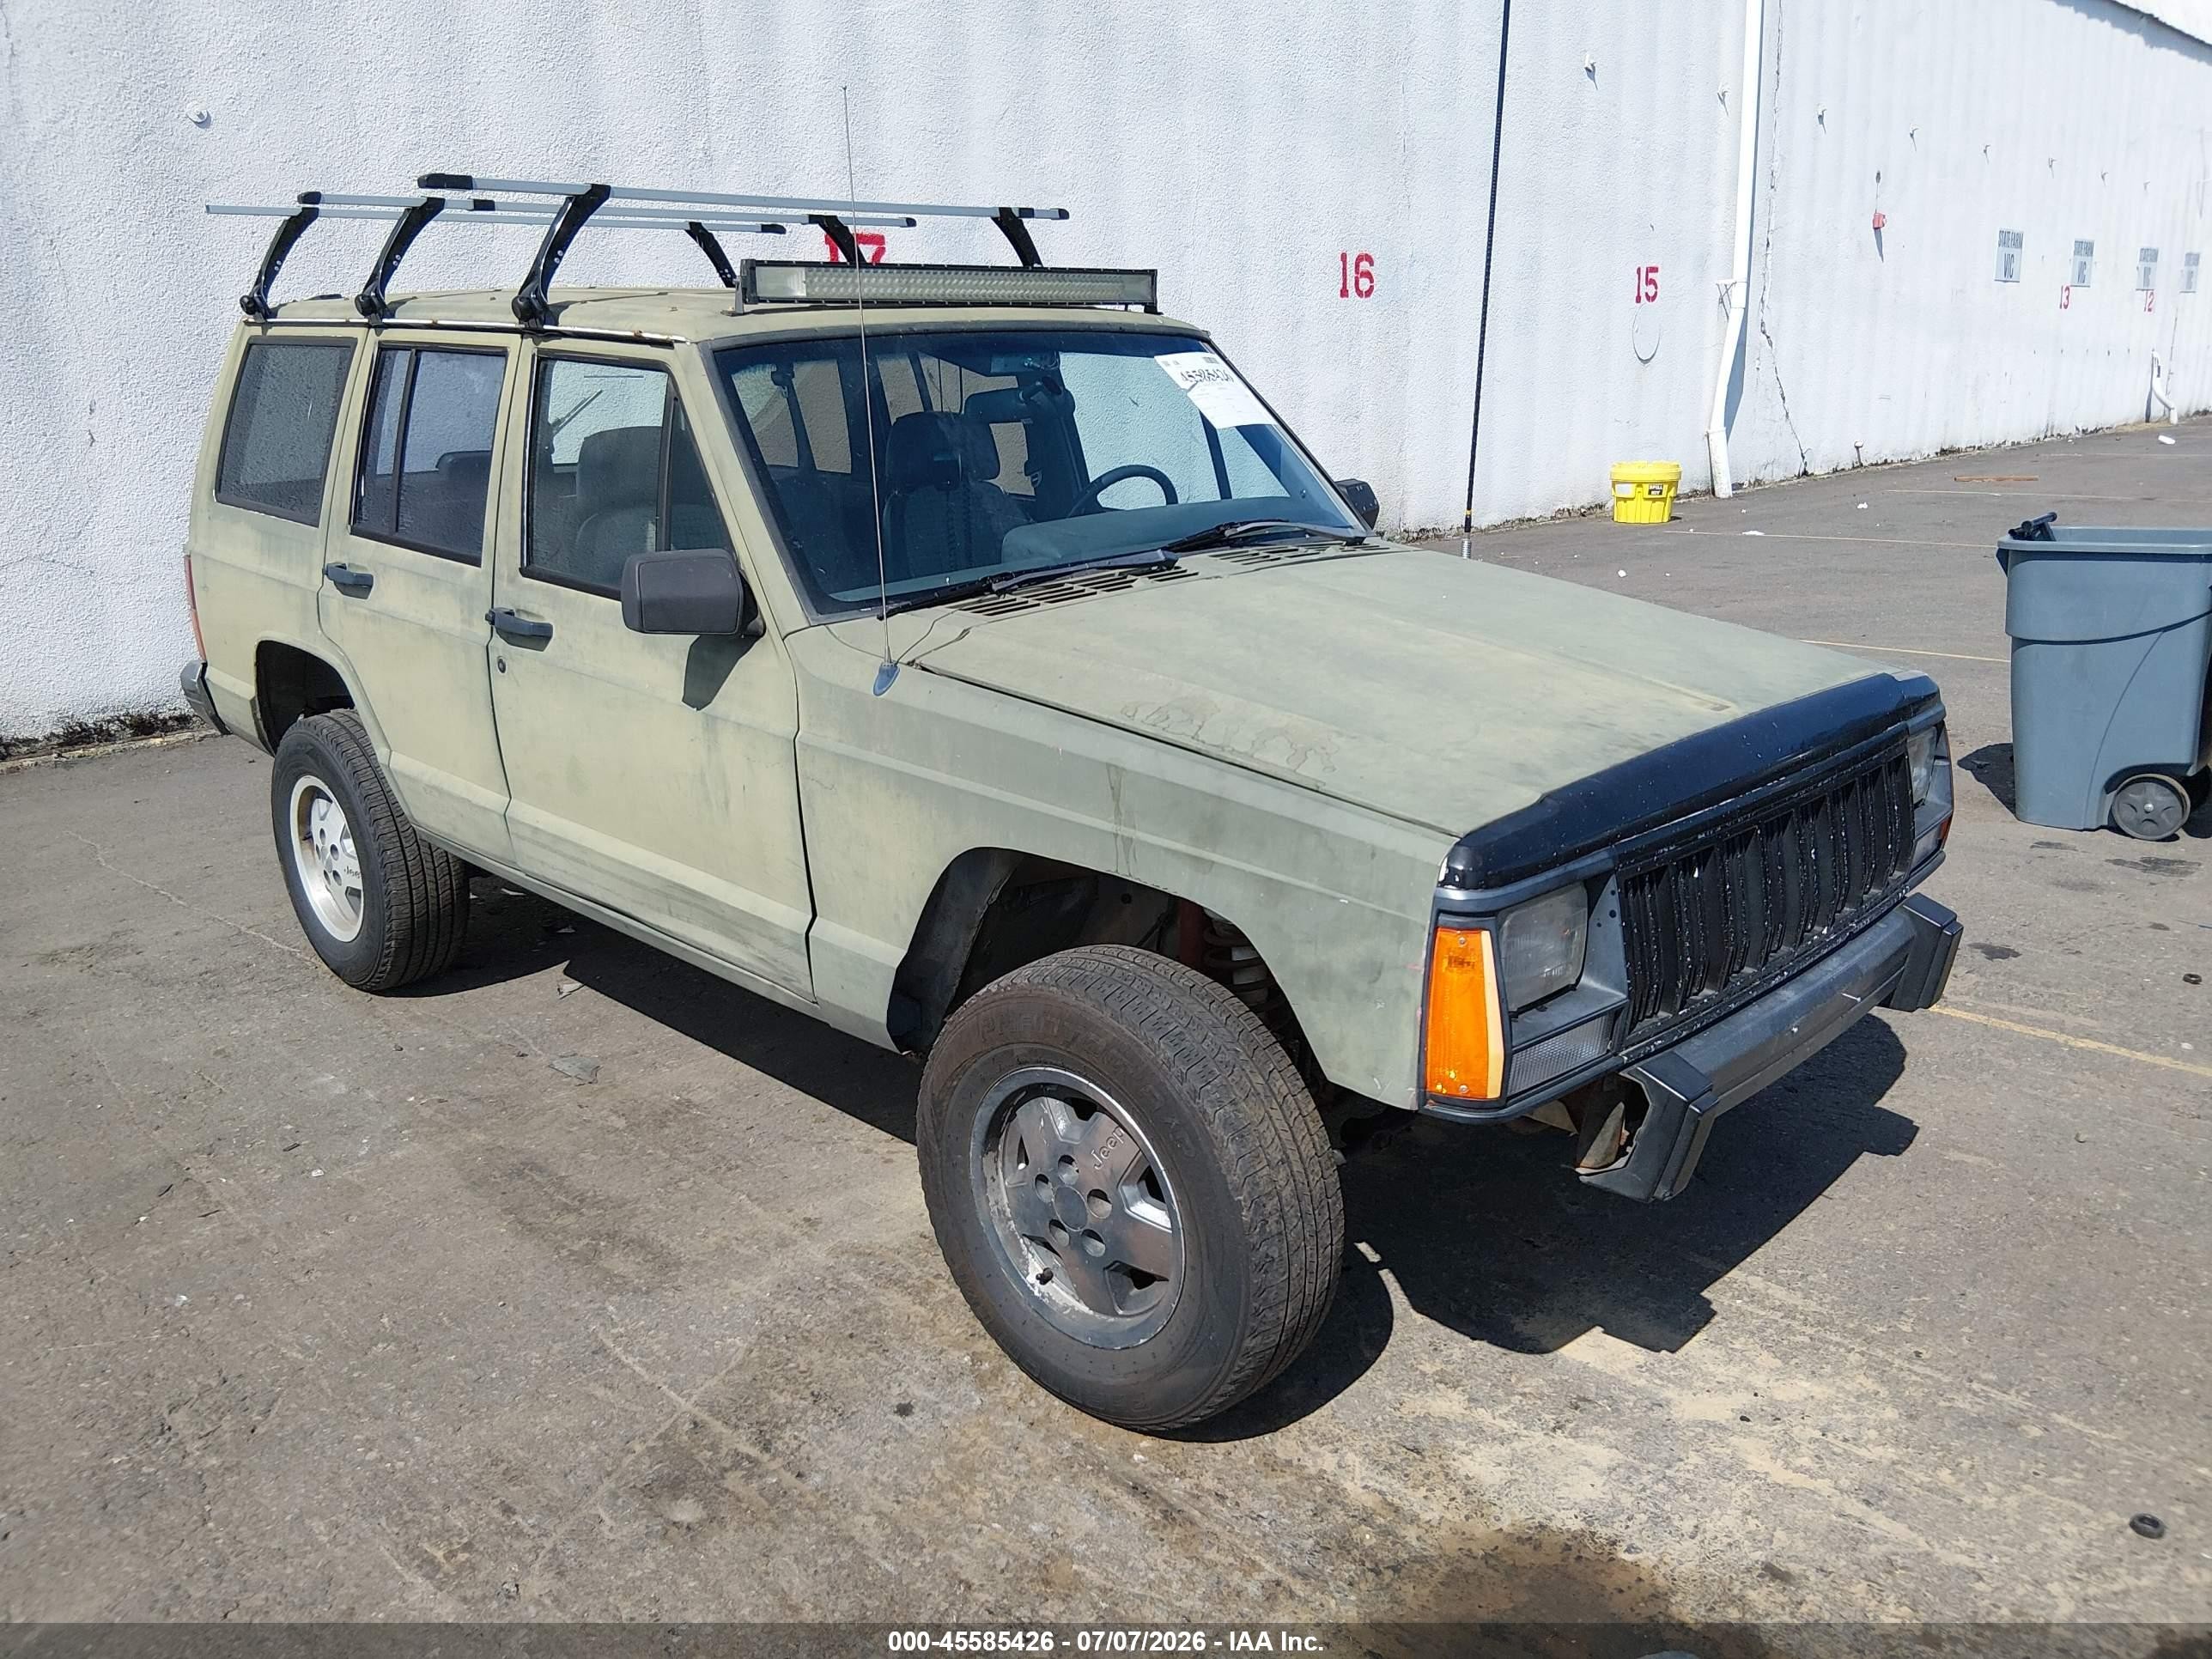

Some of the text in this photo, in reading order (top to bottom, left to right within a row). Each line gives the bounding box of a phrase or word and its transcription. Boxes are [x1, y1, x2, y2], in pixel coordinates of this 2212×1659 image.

[1340, 252, 1375, 299] 16
[1636, 266, 1659, 303] 15
[2059, 285, 2070, 309] 13
[2143, 290, 2154, 312] 12
[1091, 1125, 1126, 1170] Jeep
